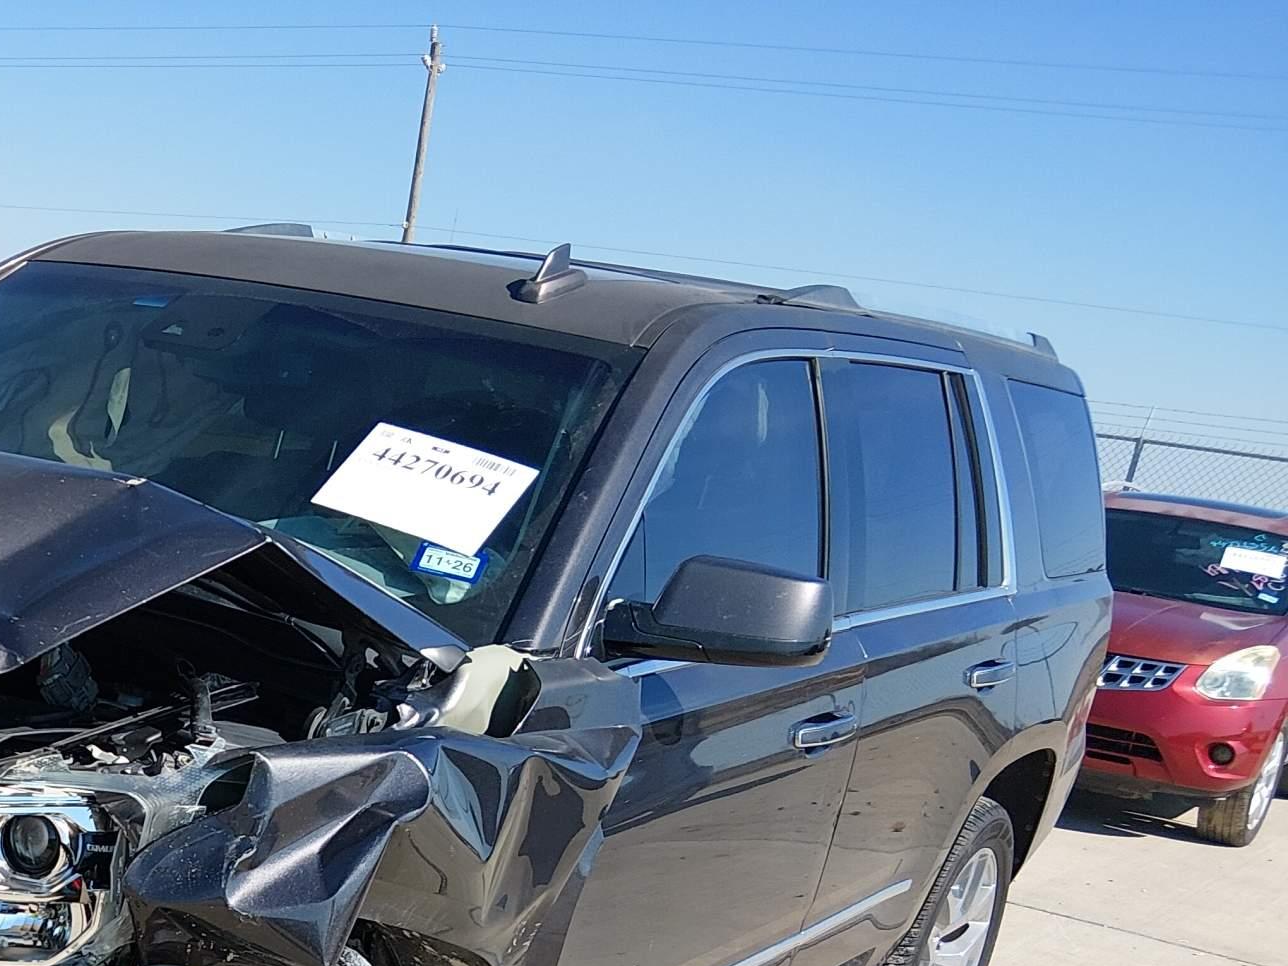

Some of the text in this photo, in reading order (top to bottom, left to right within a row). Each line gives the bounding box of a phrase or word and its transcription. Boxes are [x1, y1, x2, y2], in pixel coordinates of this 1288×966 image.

[372, 446, 502, 497] 44270694
[425, 554, 444, 566] 11
[452, 559, 474, 573] 26
